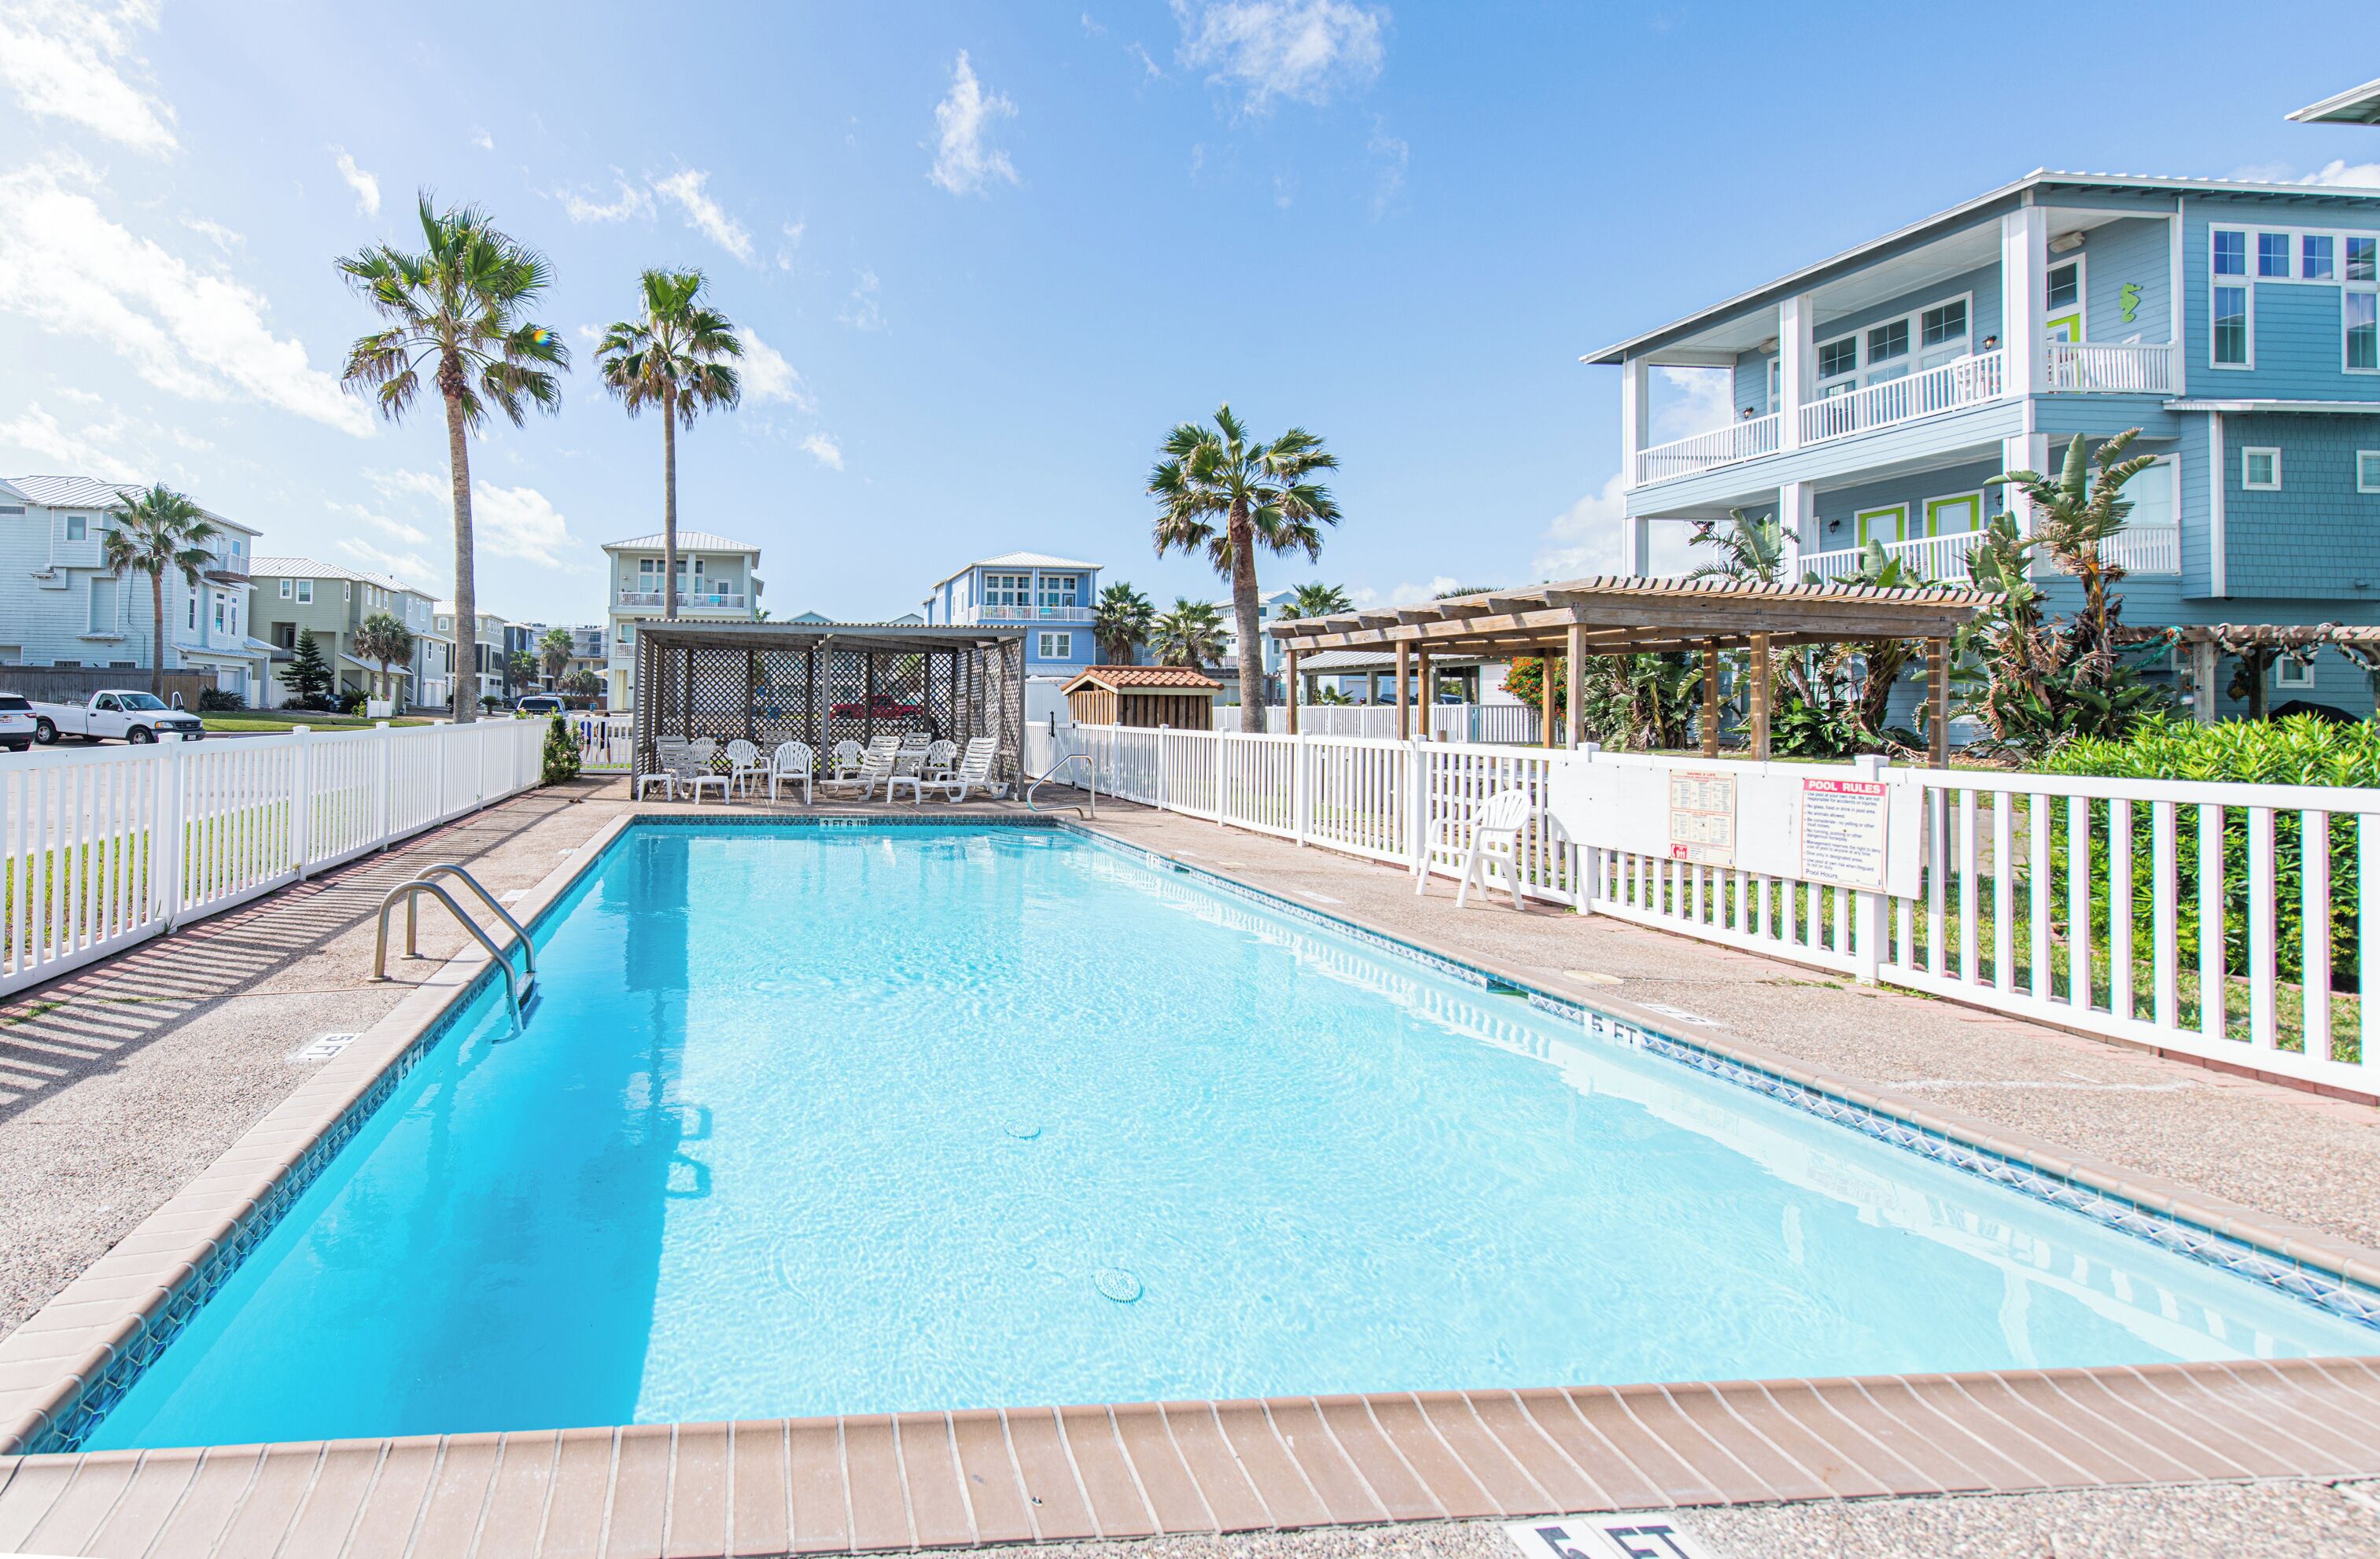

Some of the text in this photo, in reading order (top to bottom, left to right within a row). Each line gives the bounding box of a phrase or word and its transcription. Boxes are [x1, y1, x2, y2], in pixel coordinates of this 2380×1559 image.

[1808, 780, 1881, 794] POOL RULES
[1676, 850, 1686, 858] 911
[1592, 1014, 1638, 1045] 5 FT
[306, 1045, 343, 1057] FT
[401, 1057, 408, 1079] 5
